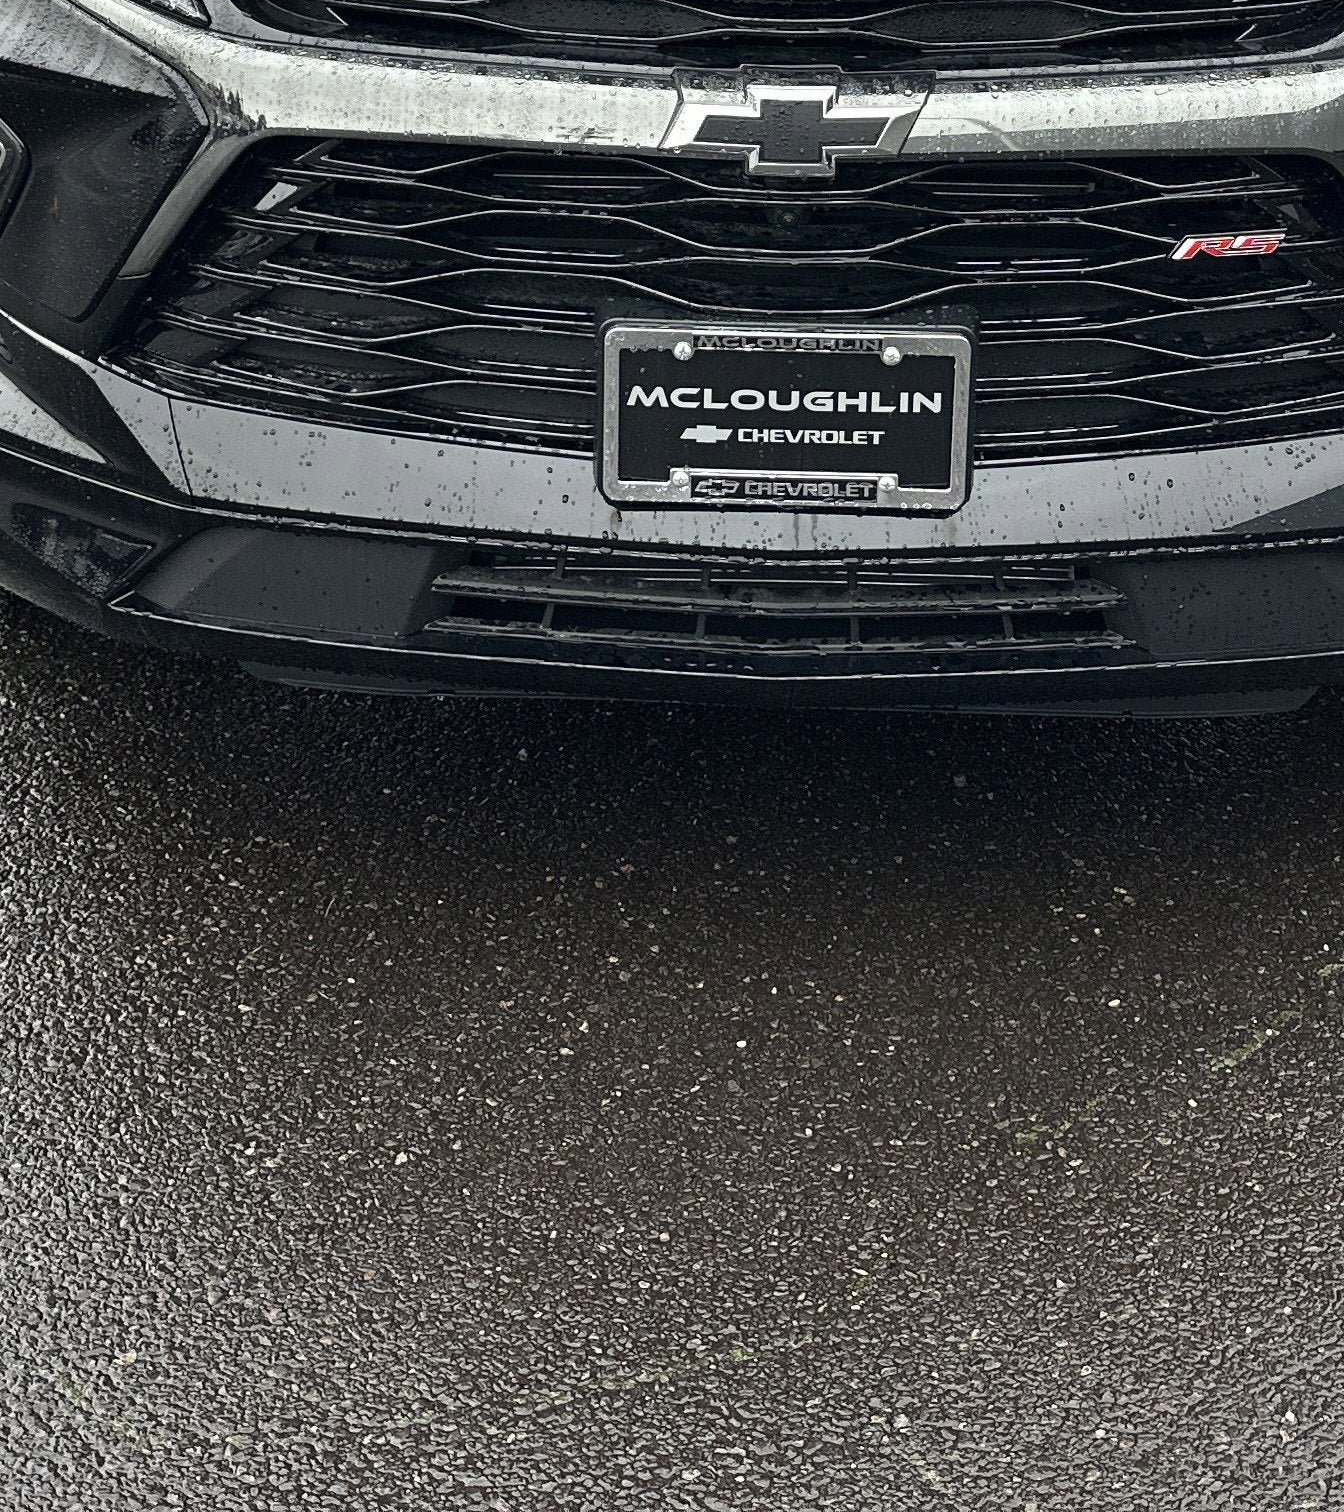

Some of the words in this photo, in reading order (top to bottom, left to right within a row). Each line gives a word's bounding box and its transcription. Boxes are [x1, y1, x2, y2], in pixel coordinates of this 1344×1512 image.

[1169, 232, 1287, 260] RS
[698, 335, 882, 352] MCLOUGHLIN
[626, 385, 942, 414] MCLOUGHLIN
[738, 428, 886, 445] CHEVROLET
[744, 480, 875, 498] CHEVROLET
